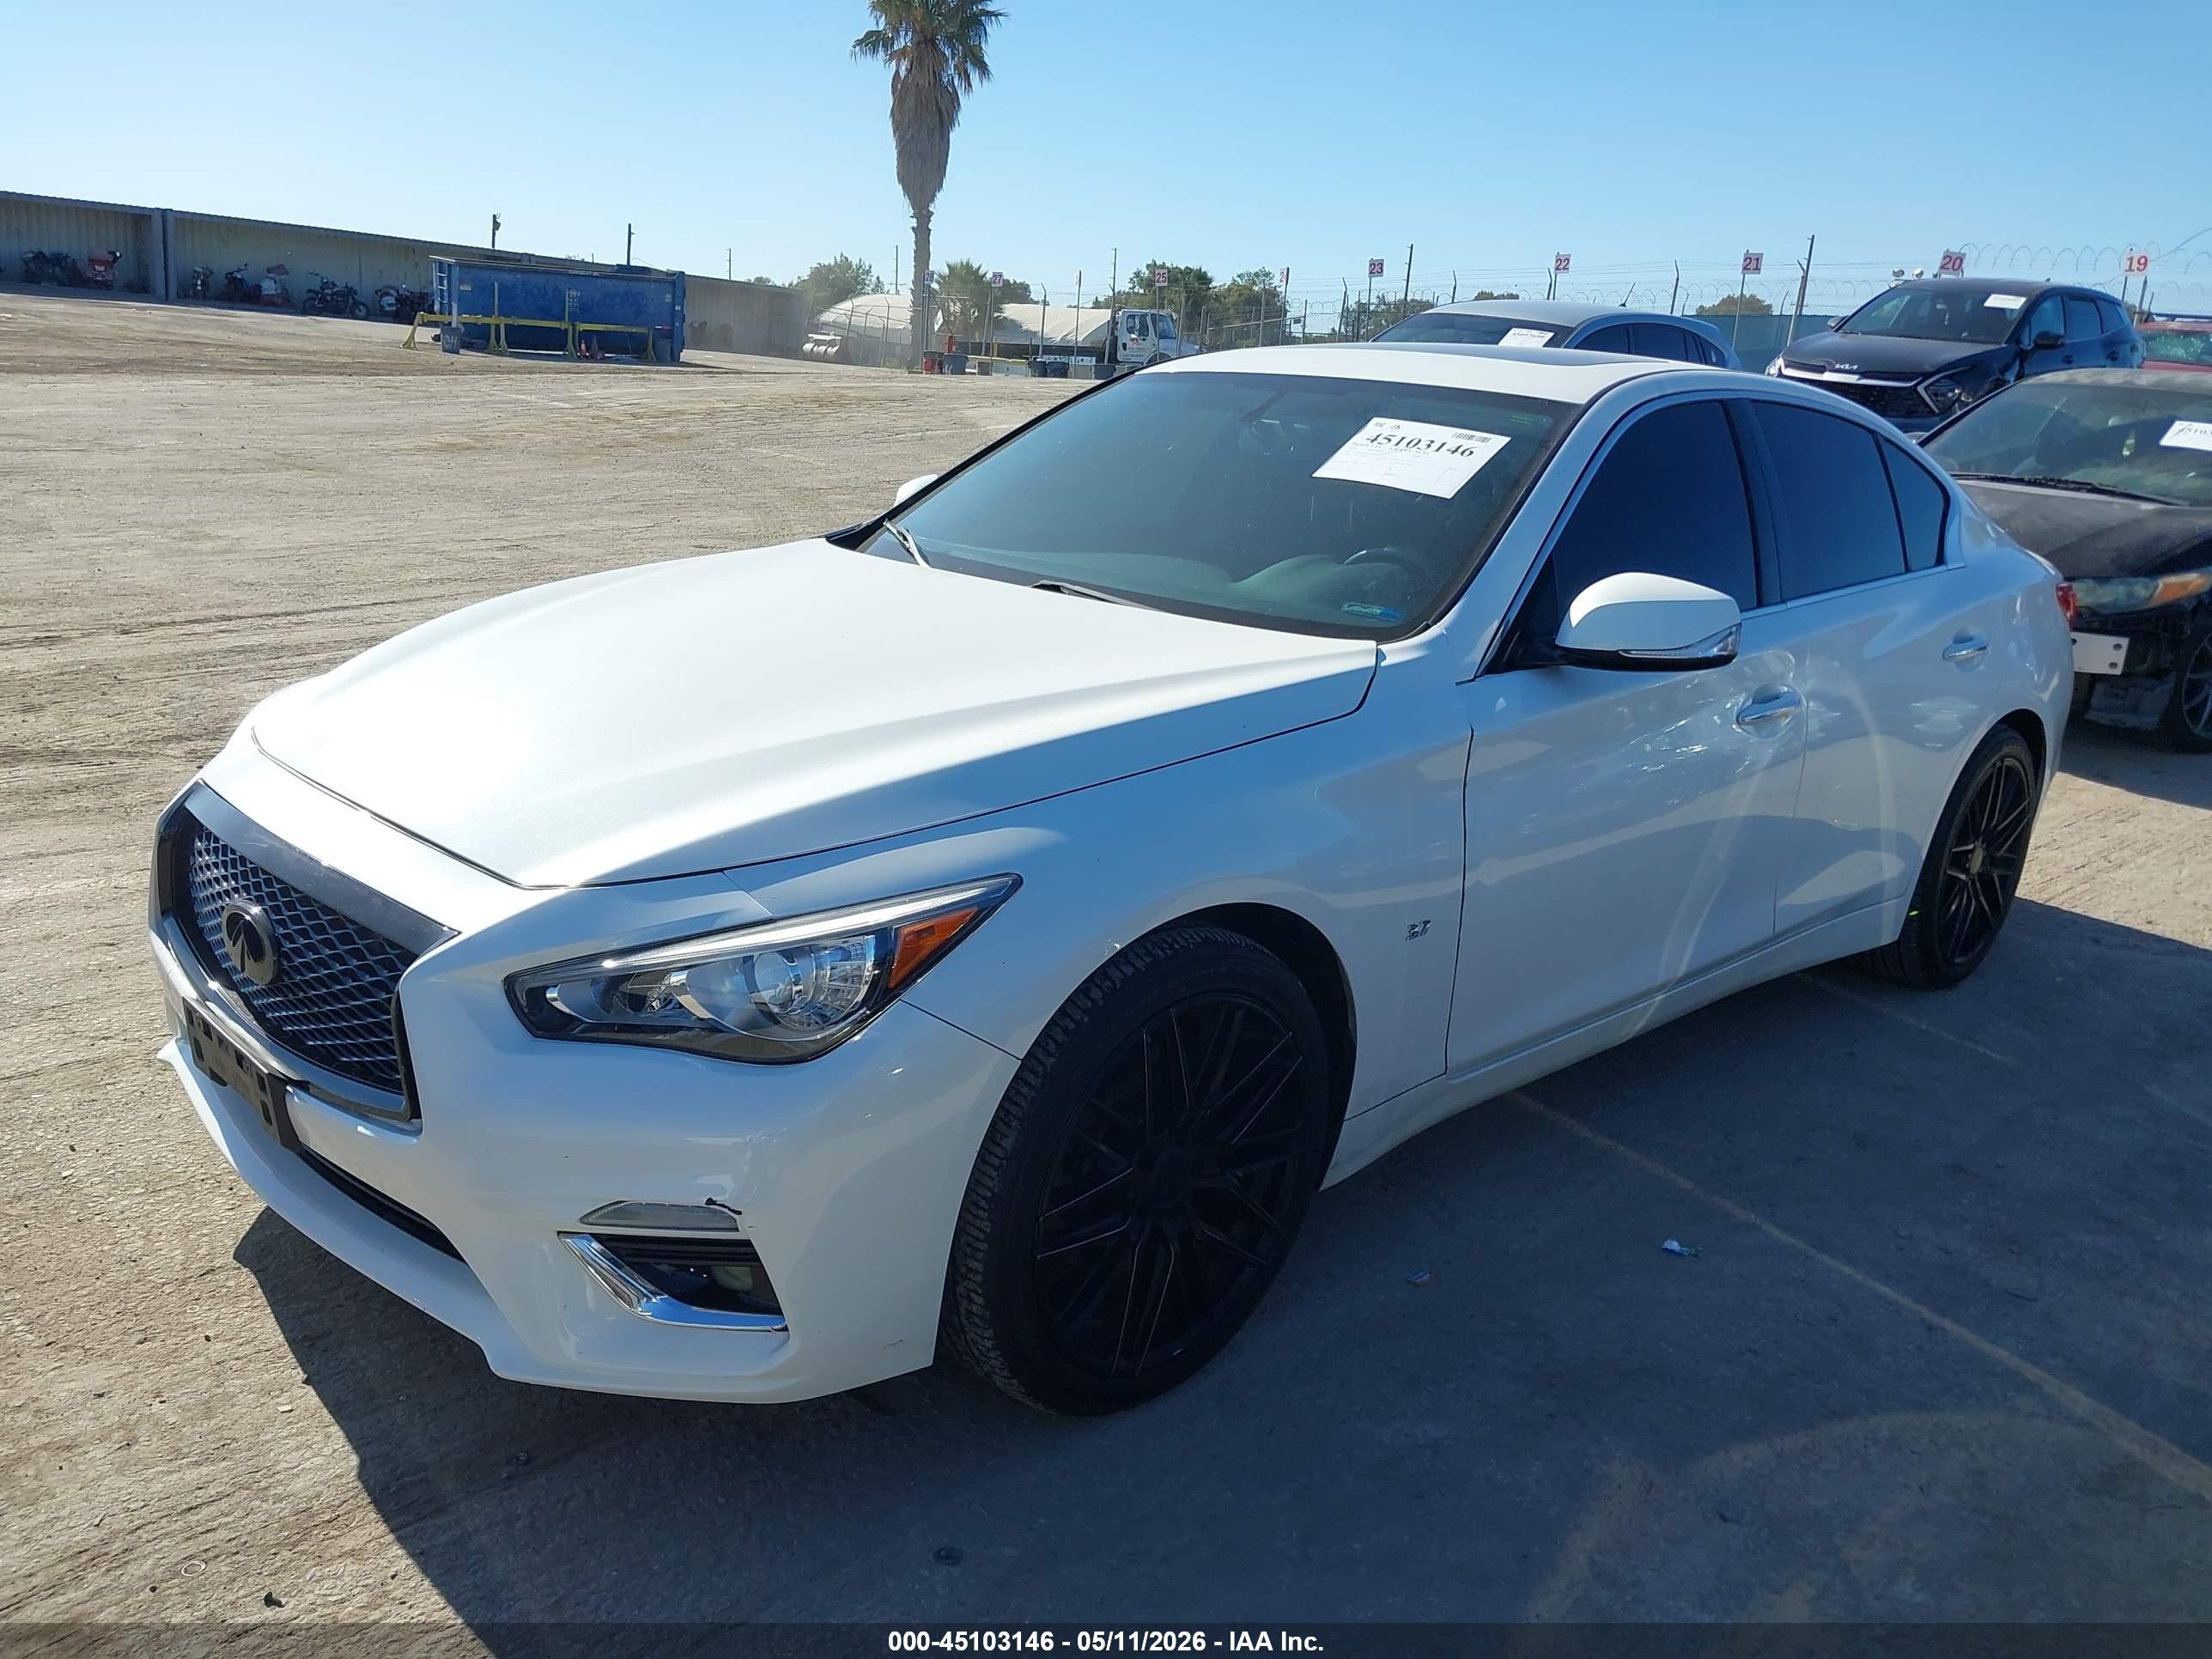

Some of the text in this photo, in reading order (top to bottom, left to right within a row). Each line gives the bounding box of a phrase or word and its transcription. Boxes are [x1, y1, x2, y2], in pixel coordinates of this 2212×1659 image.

[1369, 262, 1383, 275] 23
[1555, 258, 1570, 270] 22
[1743, 257, 1760, 270] 21
[1940, 255, 1963, 271] 20
[2124, 255, 2148, 272] 19
[993, 274, 1002, 284] 27
[1156, 272, 1167, 283] 25
[1366, 433, 1478, 458] 45103146
